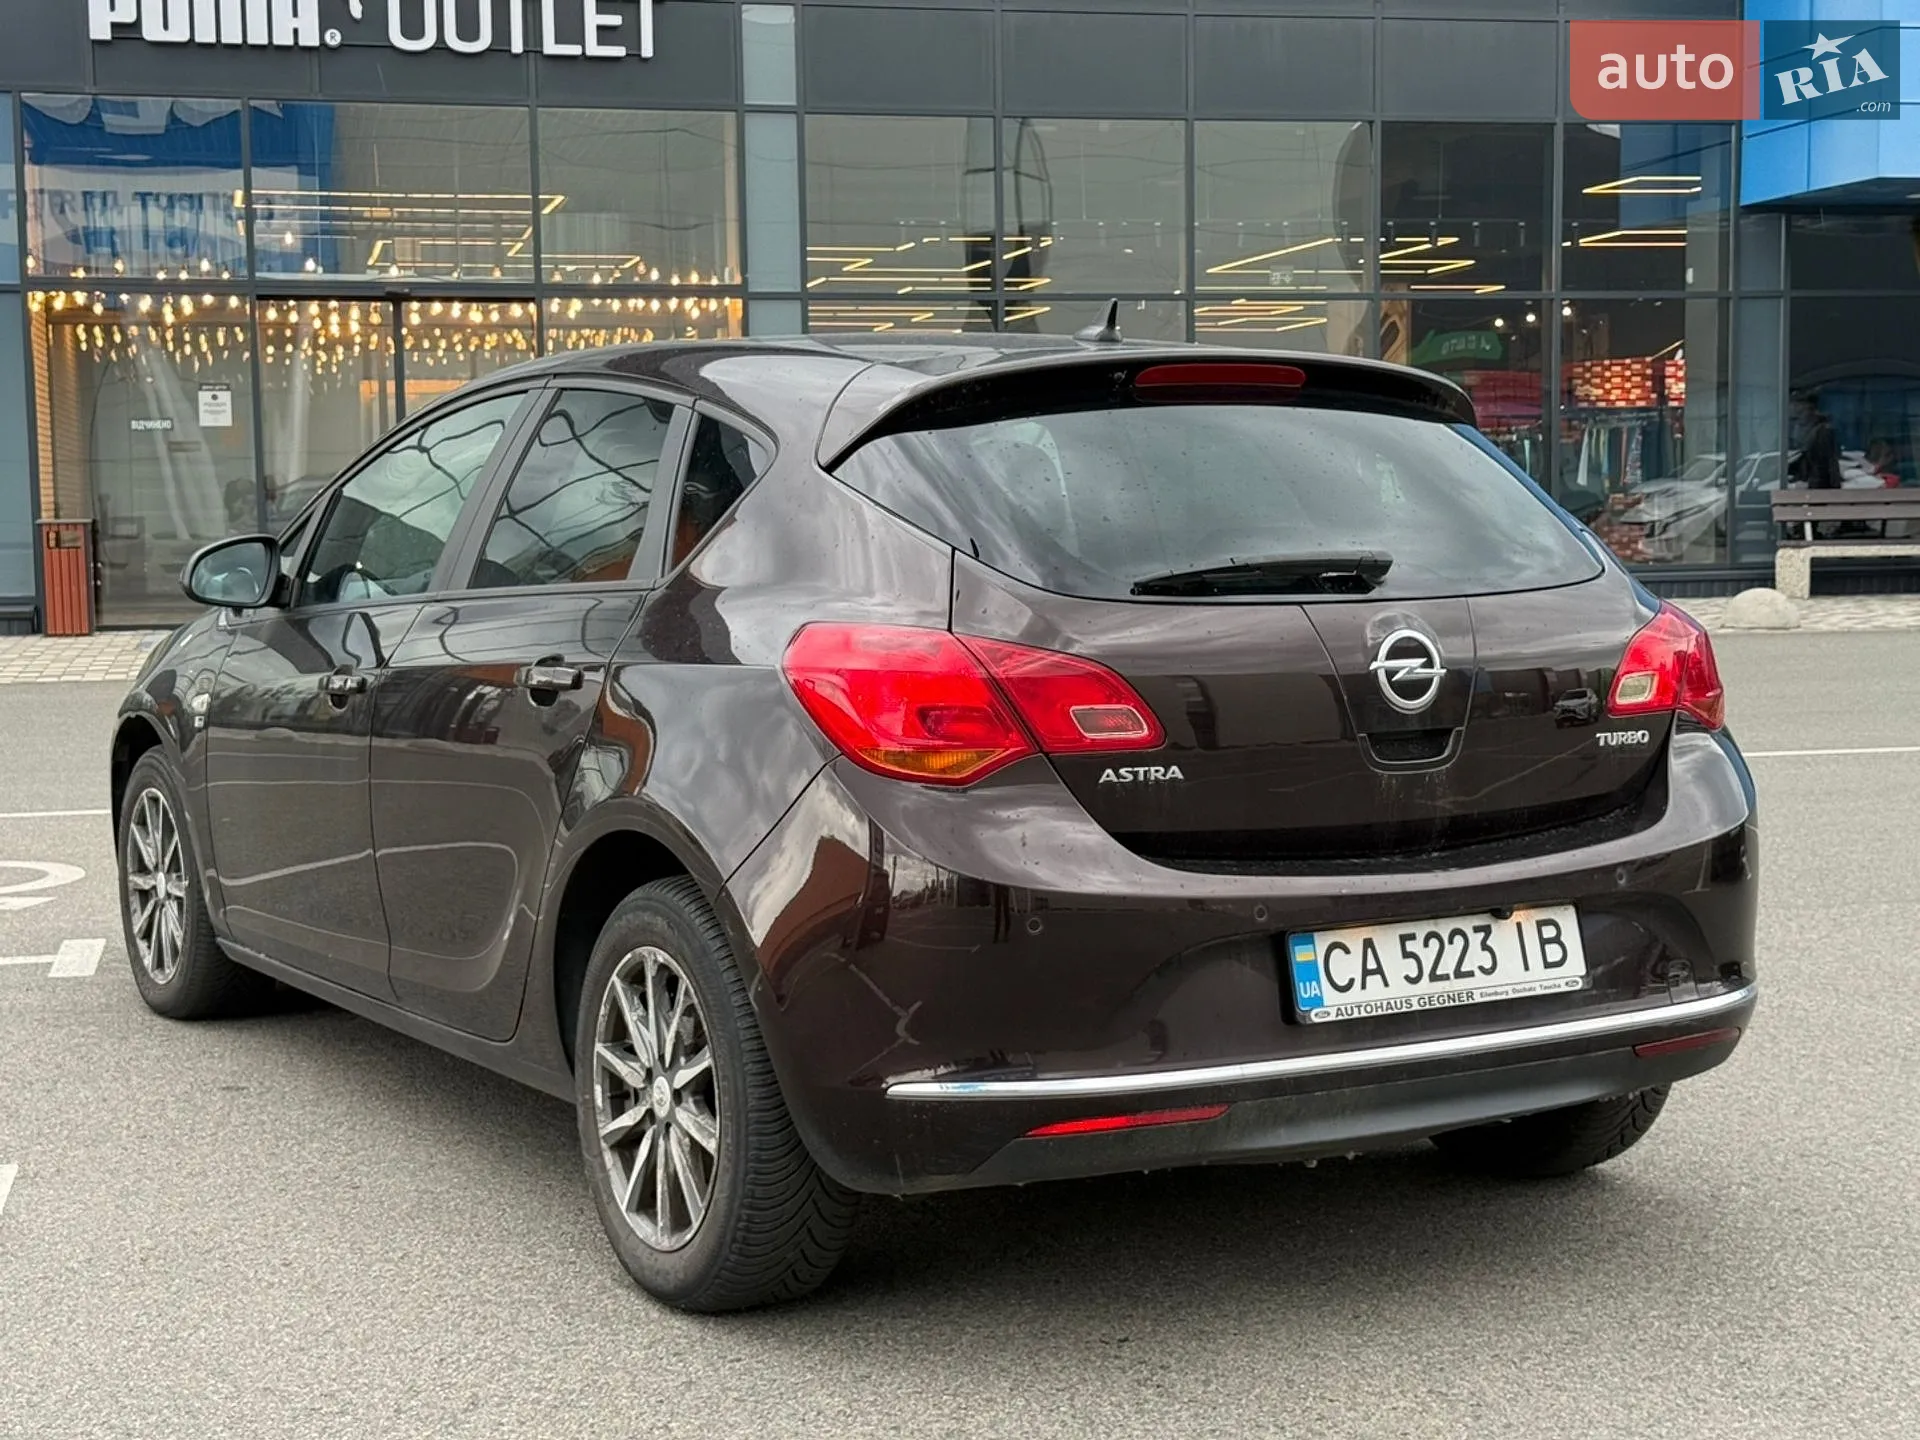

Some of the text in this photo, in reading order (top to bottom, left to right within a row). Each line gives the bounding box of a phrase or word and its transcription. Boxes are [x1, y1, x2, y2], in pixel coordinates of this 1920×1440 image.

[1595, 730, 1650, 747] TURBO
[1099, 765, 1184, 783] ASTRA
[1323, 917, 1568, 993] CA 5223 IB
[1299, 981, 1321, 999] UA
[1334, 999, 1413, 1018] AUTOHAUS
[1417, 990, 1475, 1008] GEGNER
